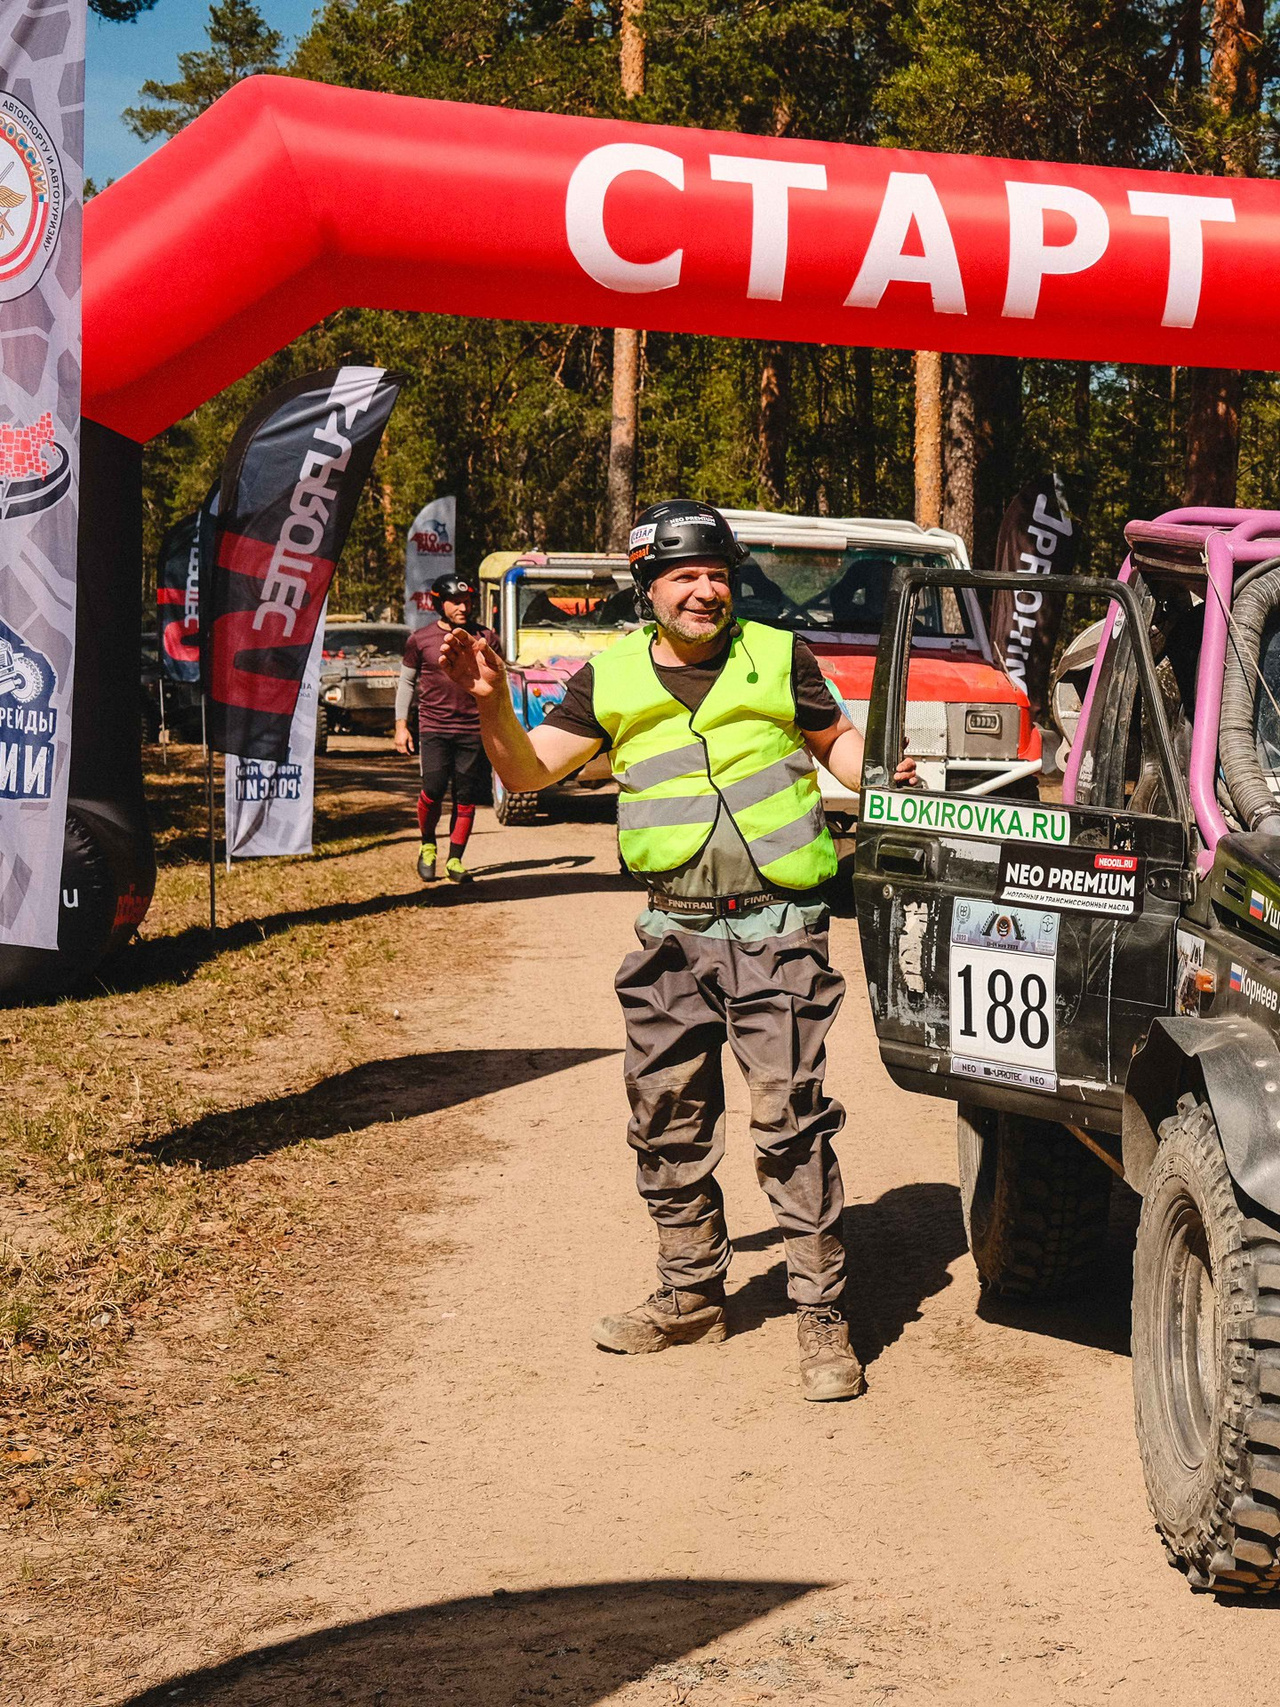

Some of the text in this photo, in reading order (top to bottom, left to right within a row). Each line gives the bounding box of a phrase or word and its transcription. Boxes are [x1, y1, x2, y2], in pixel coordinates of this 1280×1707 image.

[2, 100, 50, 152] АВТОСПОРТУ
[45, 167, 60, 252] АВТОТУРИЗМУ
[565, 142, 1236, 329] СТАРТ
[869, 794, 1066, 841] BLOKIROVKA.RU
[1005, 862, 1135, 897] NEO PREMIUM
[1099, 858, 1133, 868] NEOOIL.RU
[668, 899, 715, 909] FINNTRAIL
[1006, 891, 1039, 901] МОТОРНЫЕ
[1045, 896, 1107, 909] ТРАНСМИССИОННЫЕ
[958, 965, 1049, 1049] 188
[1239, 968, 1278, 1015] Корнеев
[962, 1064, 977, 1073] NEO
[1030, 1076, 1045, 1085] NEO
